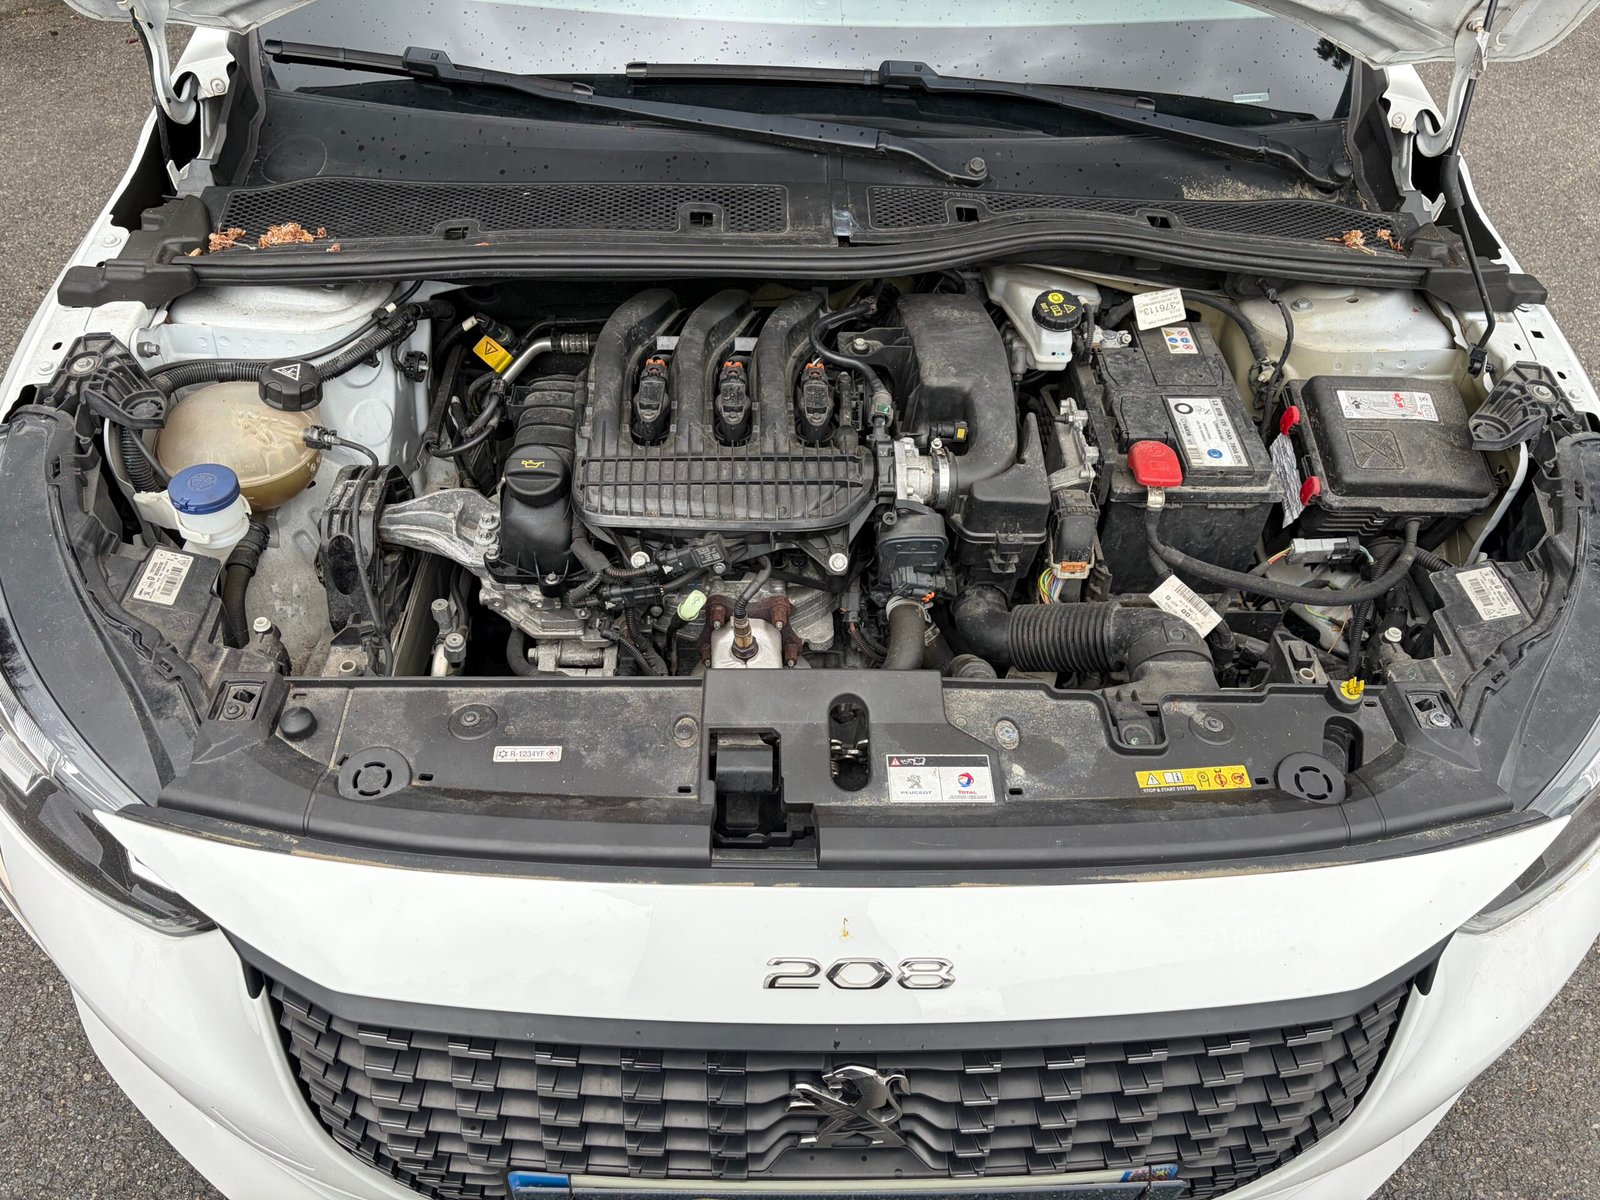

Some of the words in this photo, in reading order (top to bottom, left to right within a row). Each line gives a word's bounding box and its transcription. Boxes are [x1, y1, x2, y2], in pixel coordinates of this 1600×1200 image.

[1143, 301, 1176, 316] 376113
[510, 750, 546, 758] R-1234YF
[763, 956, 956, 990] 208
